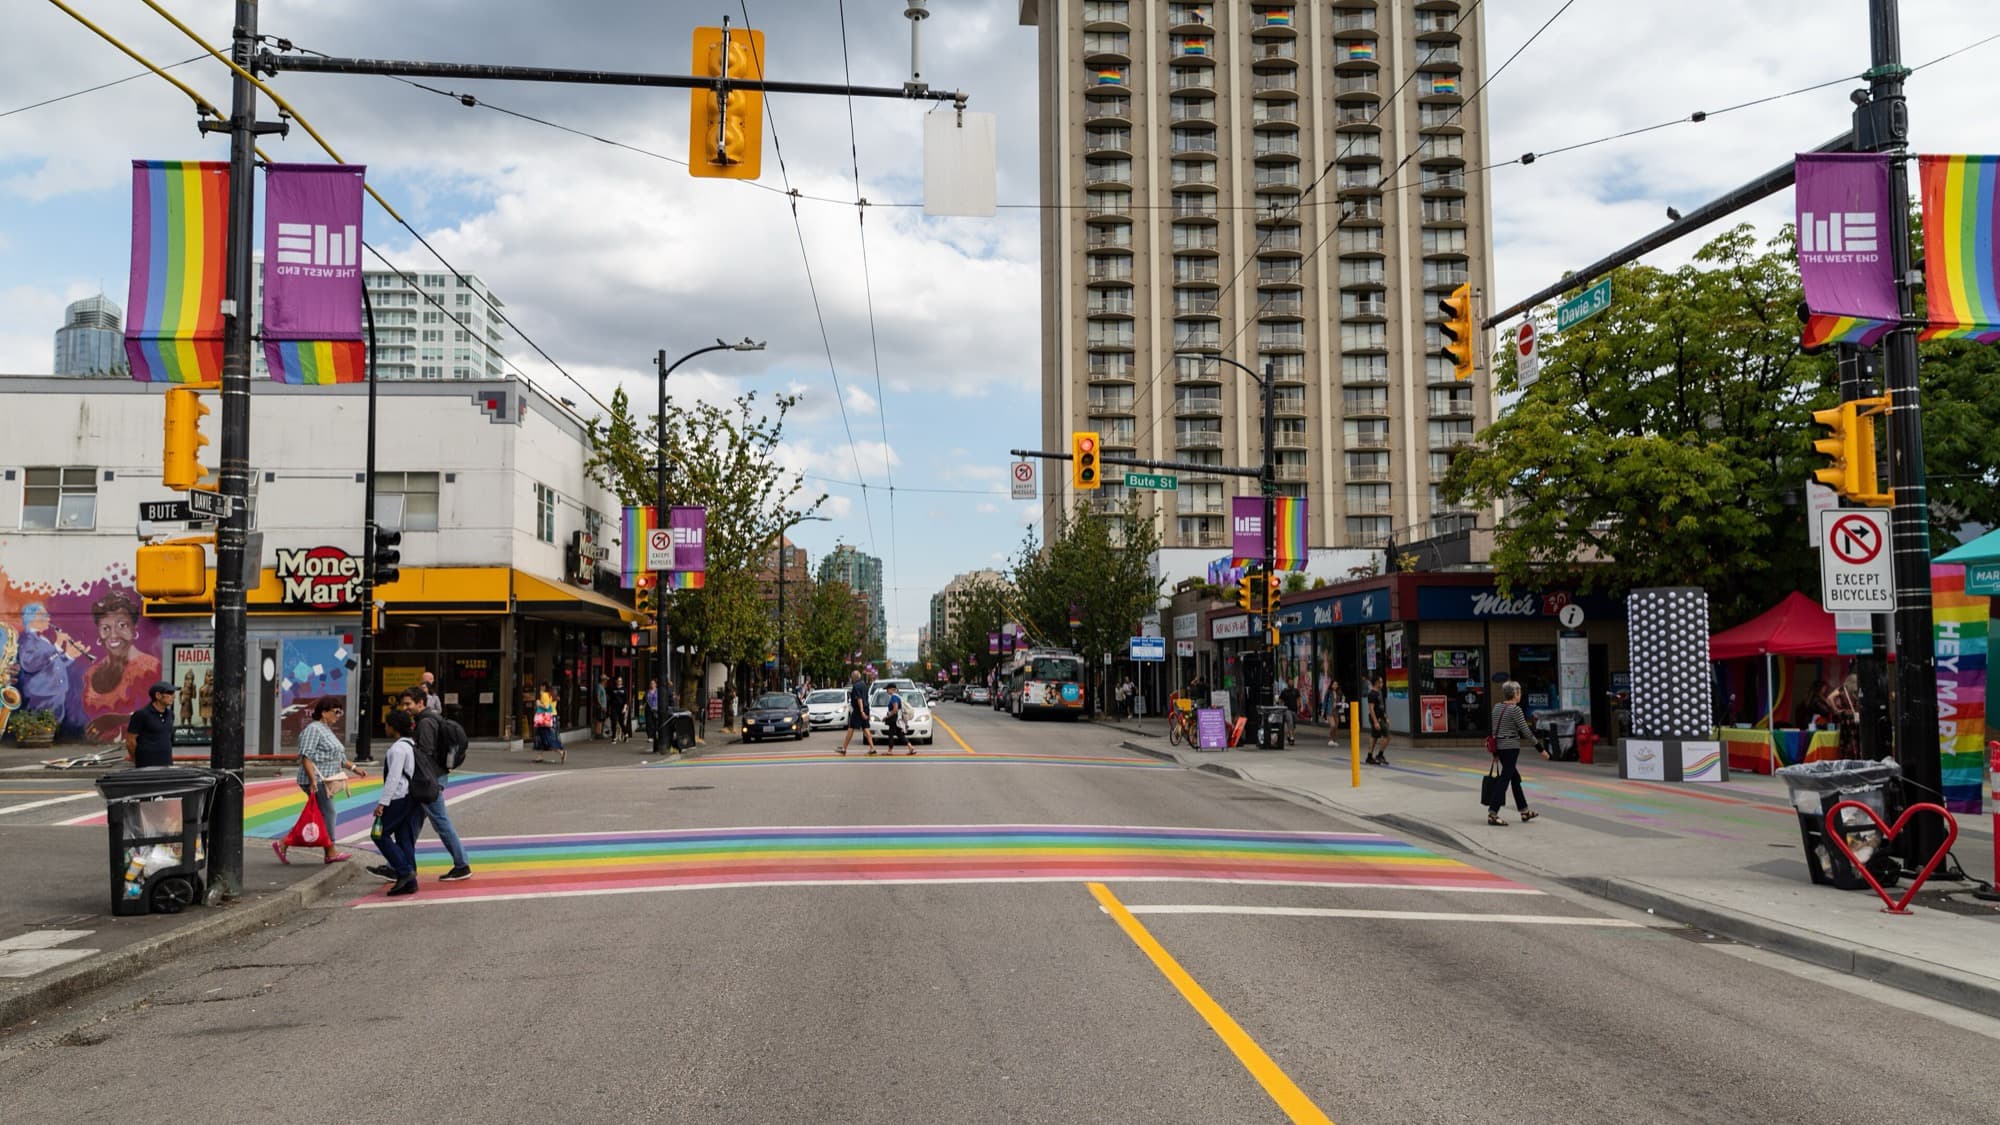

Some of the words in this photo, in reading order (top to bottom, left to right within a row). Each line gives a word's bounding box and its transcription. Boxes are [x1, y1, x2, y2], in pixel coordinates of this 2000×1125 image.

[1803, 254, 1824, 263] THE
[1825, 254, 1854, 263] WEST
[1856, 254, 1879, 262] END
[1562, 300, 1590, 326] Davie
[1593, 287, 1605, 308] St
[1130, 475, 1155, 487] Bute
[1160, 478, 1173, 488] St
[149, 503, 178, 519] BUTE
[194, 492, 212, 511] DAVIE
[277, 549, 364, 584] Money
[1836, 573, 1880, 586] EXCEPT
[284, 577, 357, 604] Mart
[1831, 589, 1888, 601] BICYCLES
[1471, 592, 1536, 616] Mac's
[178, 650, 211, 663] HAIDA
[1937, 620, 1961, 674] HEY
[1936, 679, 1959, 757] MARY
